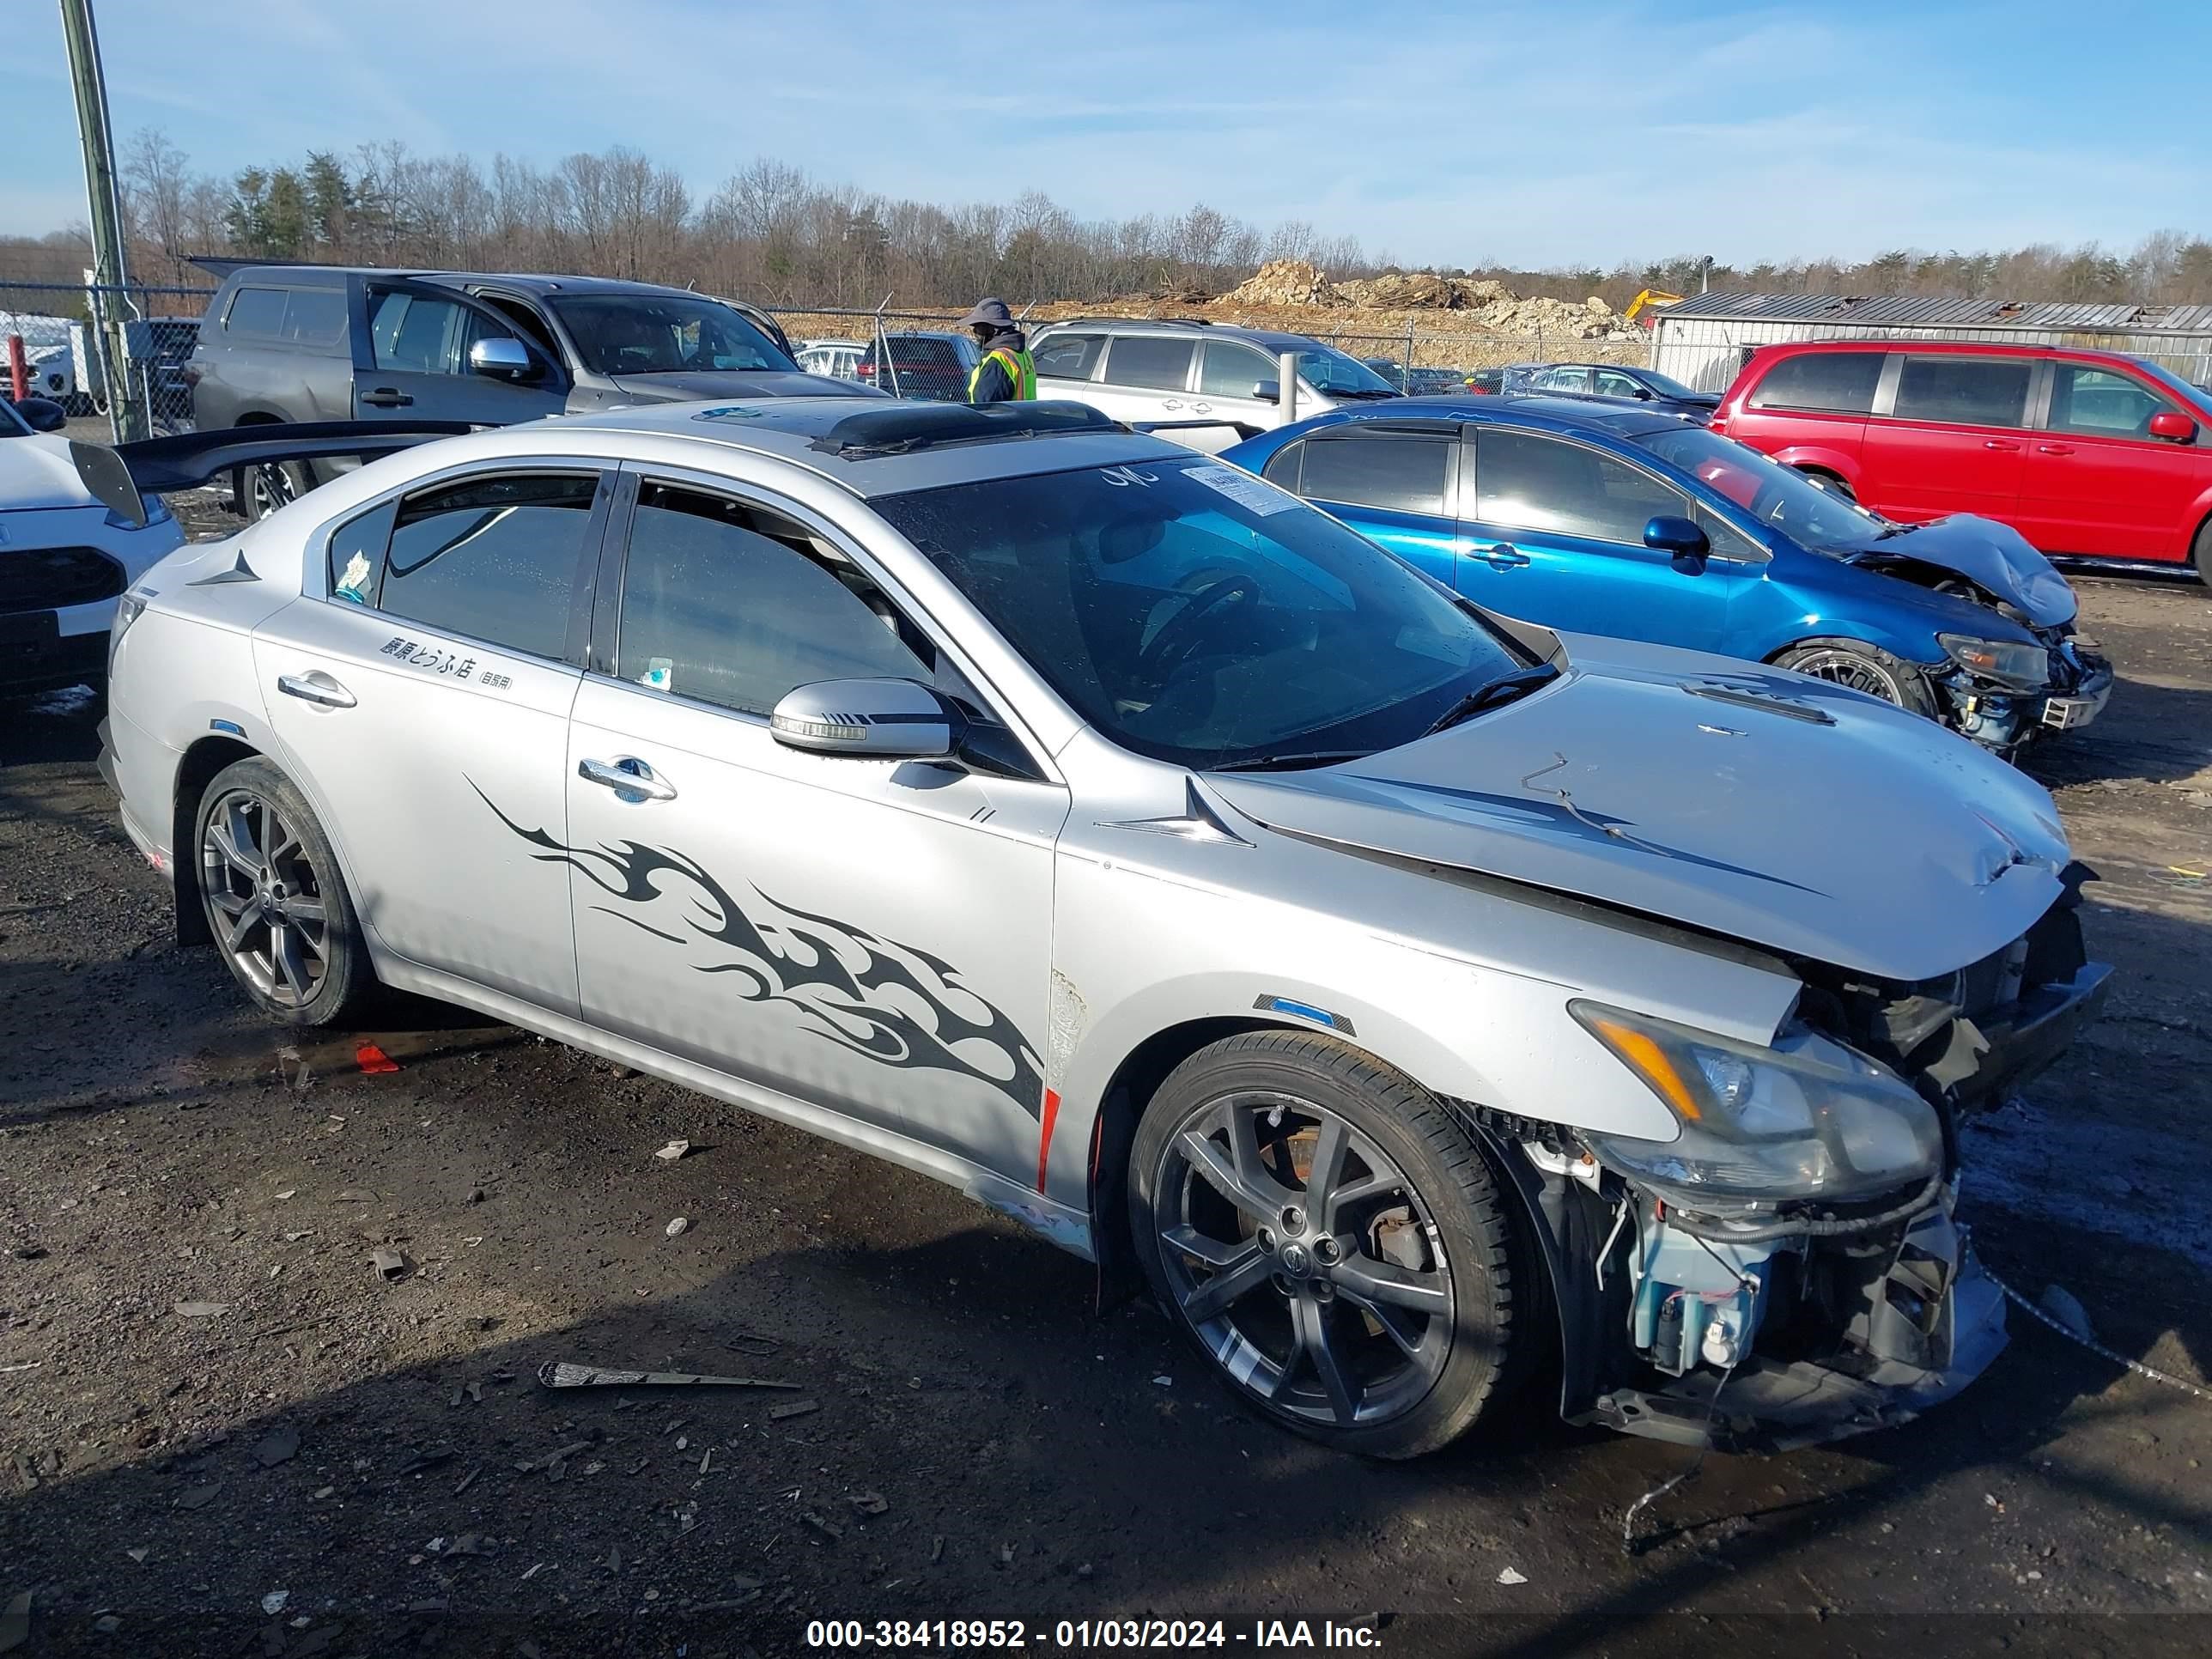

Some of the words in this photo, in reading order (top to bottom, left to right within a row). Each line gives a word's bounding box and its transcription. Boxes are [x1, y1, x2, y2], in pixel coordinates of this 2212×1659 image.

[380, 636, 477, 679] 藤原とうふ店
